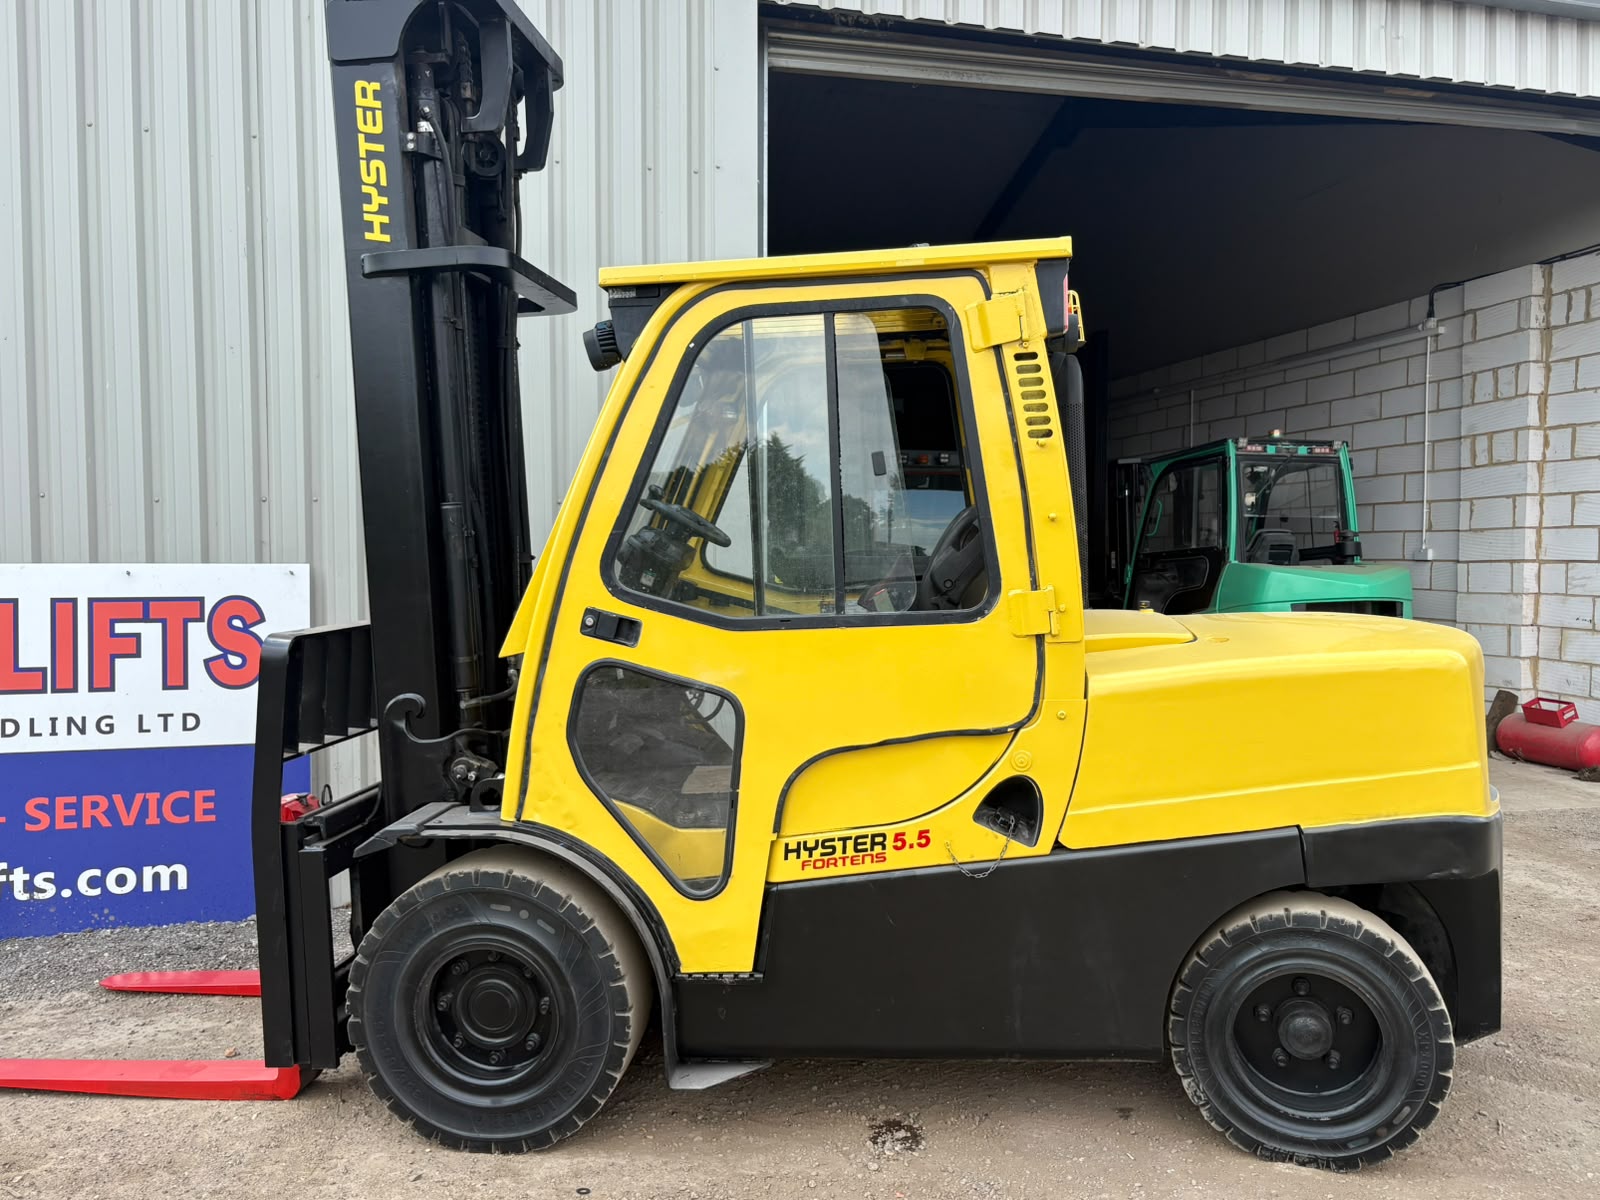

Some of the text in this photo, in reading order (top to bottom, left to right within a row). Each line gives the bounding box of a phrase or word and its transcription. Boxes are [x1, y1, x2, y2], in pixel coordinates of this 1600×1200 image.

[354, 79, 392, 243] HYSTER
[0, 594, 266, 693] LIFTS
[0, 712, 201, 739] DLING LTD
[25, 789, 217, 832] SERVICE
[783, 829, 931, 861] HYSTER 5.5
[801, 851, 888, 871] FORTENS
